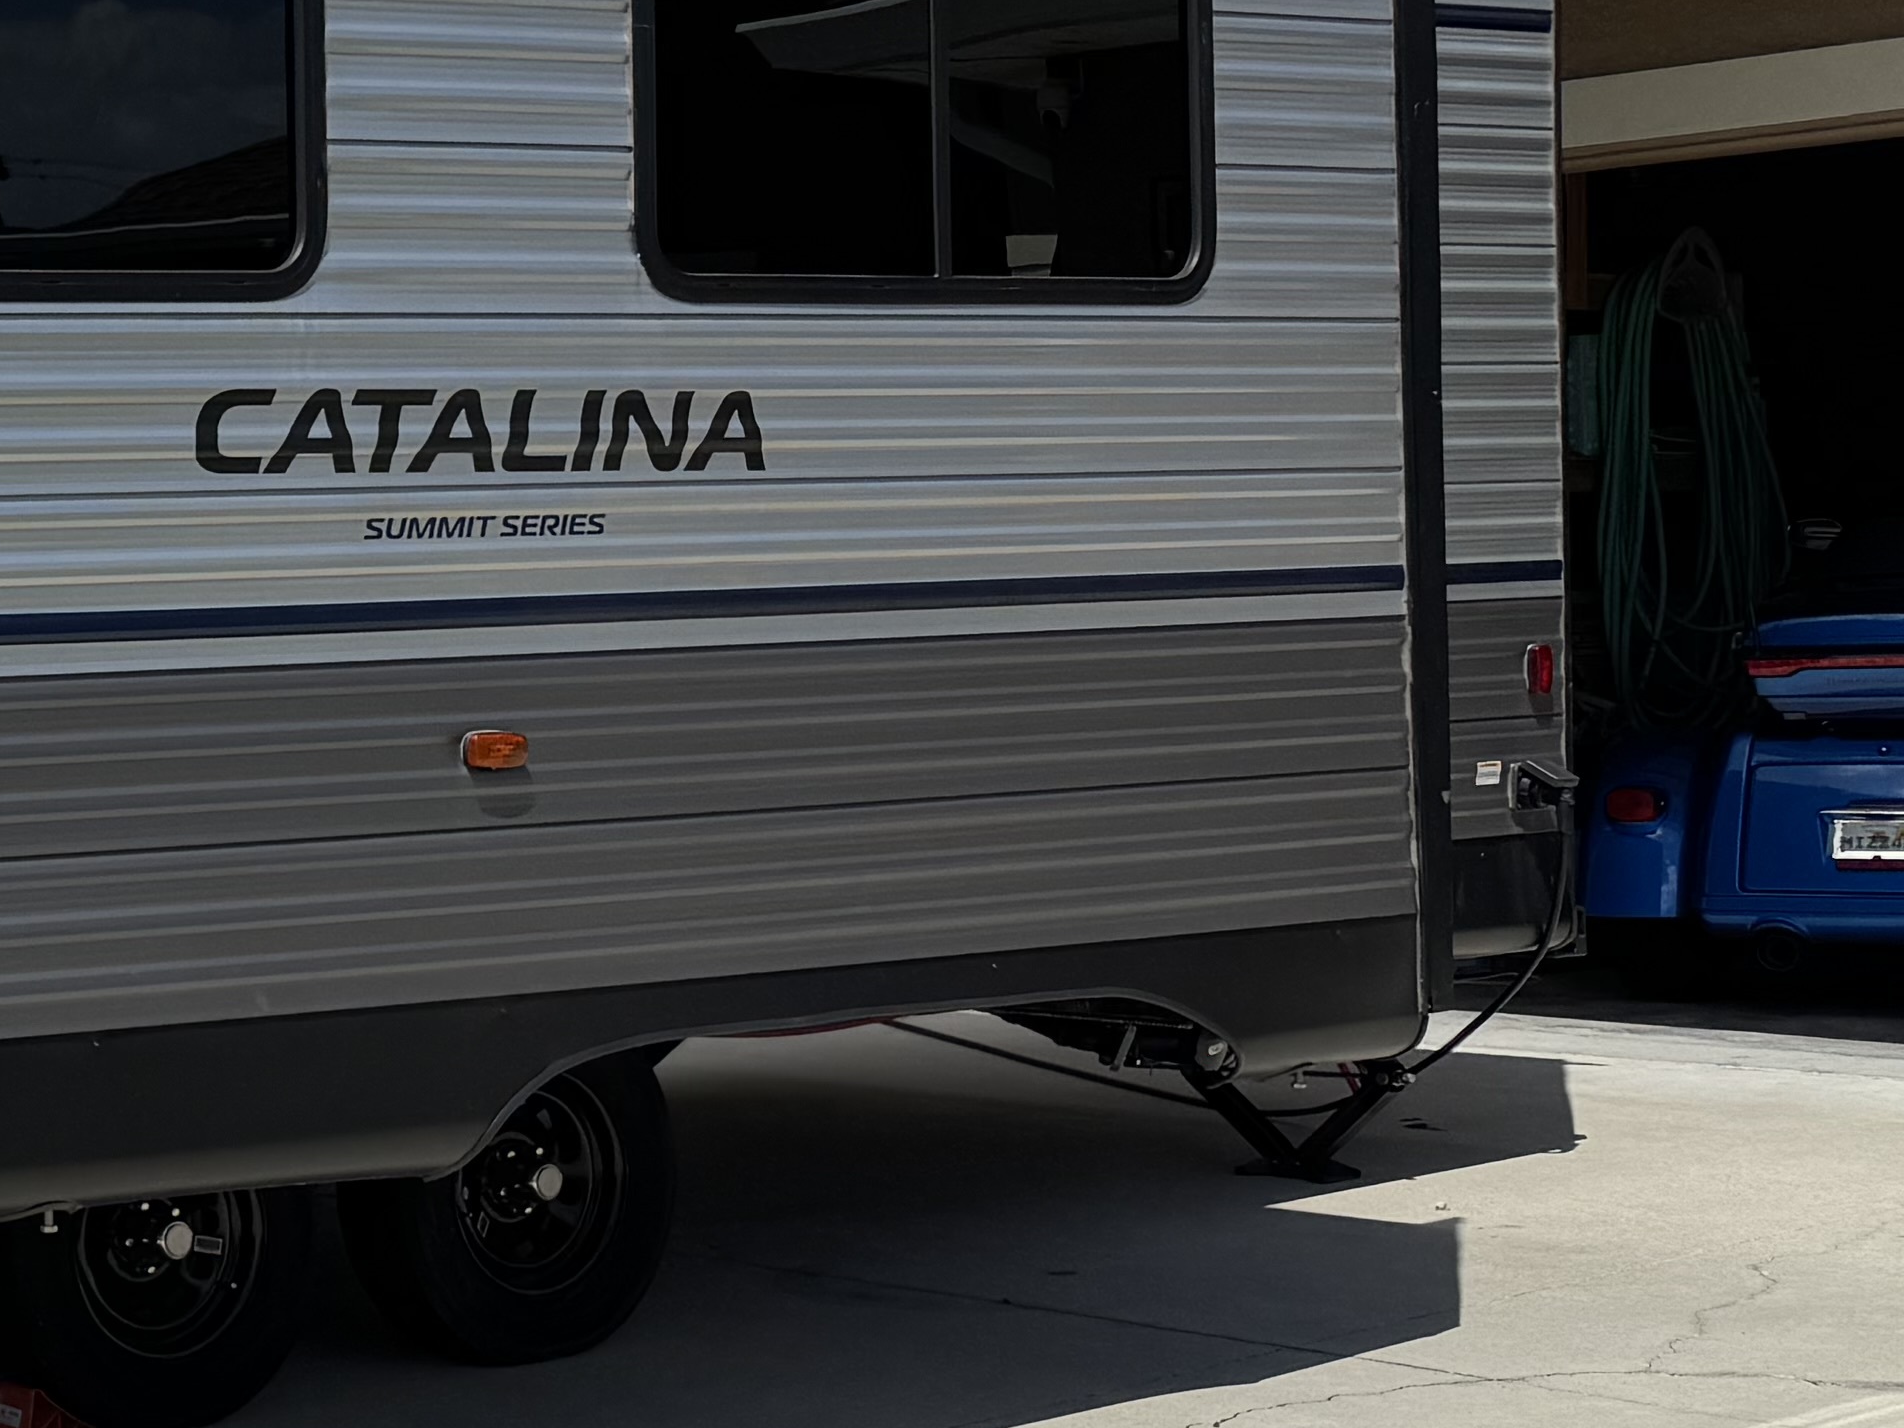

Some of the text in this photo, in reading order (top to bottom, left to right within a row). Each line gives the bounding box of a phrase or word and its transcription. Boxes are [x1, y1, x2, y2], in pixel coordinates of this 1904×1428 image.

[195, 388, 766, 474] CATALINA
[363, 513, 606, 540] SUMMIT SERIES
